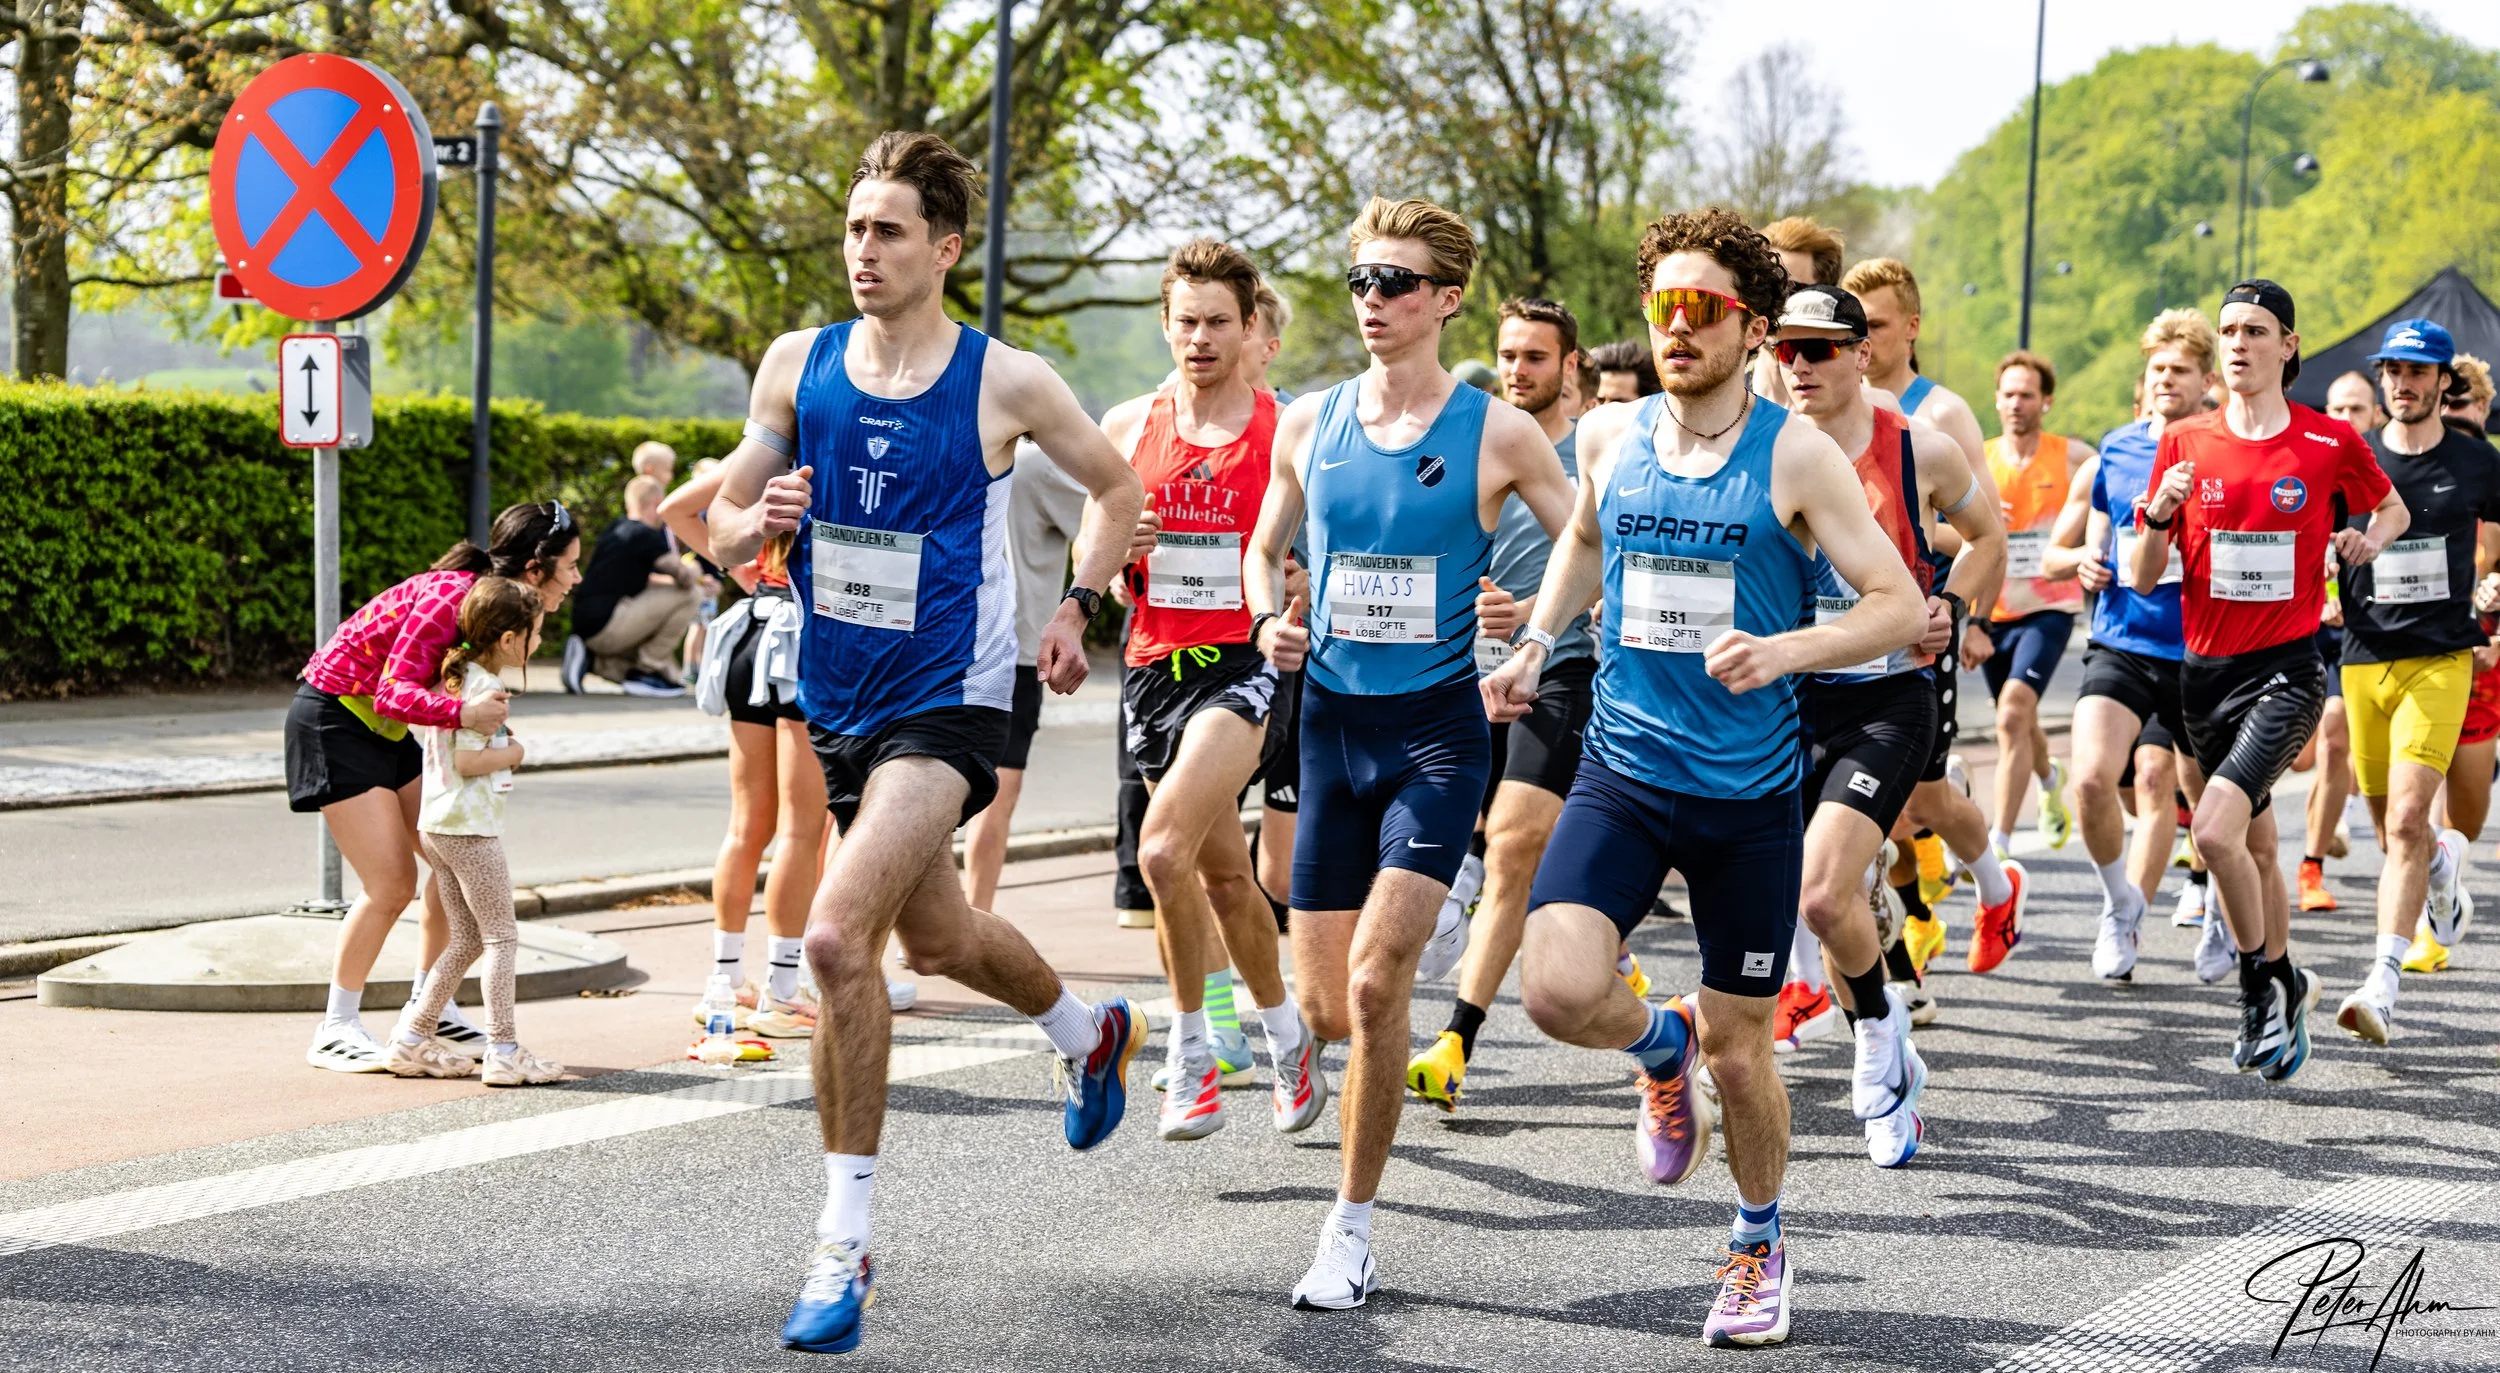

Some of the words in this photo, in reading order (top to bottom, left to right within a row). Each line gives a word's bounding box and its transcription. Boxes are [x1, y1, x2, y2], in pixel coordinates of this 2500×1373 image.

[457, 141, 470, 161] 2
[859, 416, 896, 428] CRAFT
[2282, 496, 2294, 505] AC
[1158, 503, 1236, 525] athletics
[820, 524, 881, 546] STRANDVEJEN
[883, 533, 897, 548] 5K
[1616, 513, 1749, 547] SPARTA
[1209, 536, 1221, 546] 5K
[2218, 532, 2267, 543] STRANDVEJEN
[2269, 534, 2279, 543] 5K
[1340, 555, 1398, 569] STRANDVEJEN
[1400, 558, 1413, 570] 5K
[1632, 555, 1694, 573] STRANDVEJEN
[1696, 562, 1710, 574] 5K
[1182, 576, 1204, 587] 506
[2241, 571, 2262, 581] 565
[2400, 575, 2419, 584] 563
[844, 582, 871, 597] 498
[1344, 573, 1413, 597] HVASS
[1367, 605, 1393, 617] 517
[1660, 611, 1686, 624] 551
[1490, 646, 1502, 655] 11
